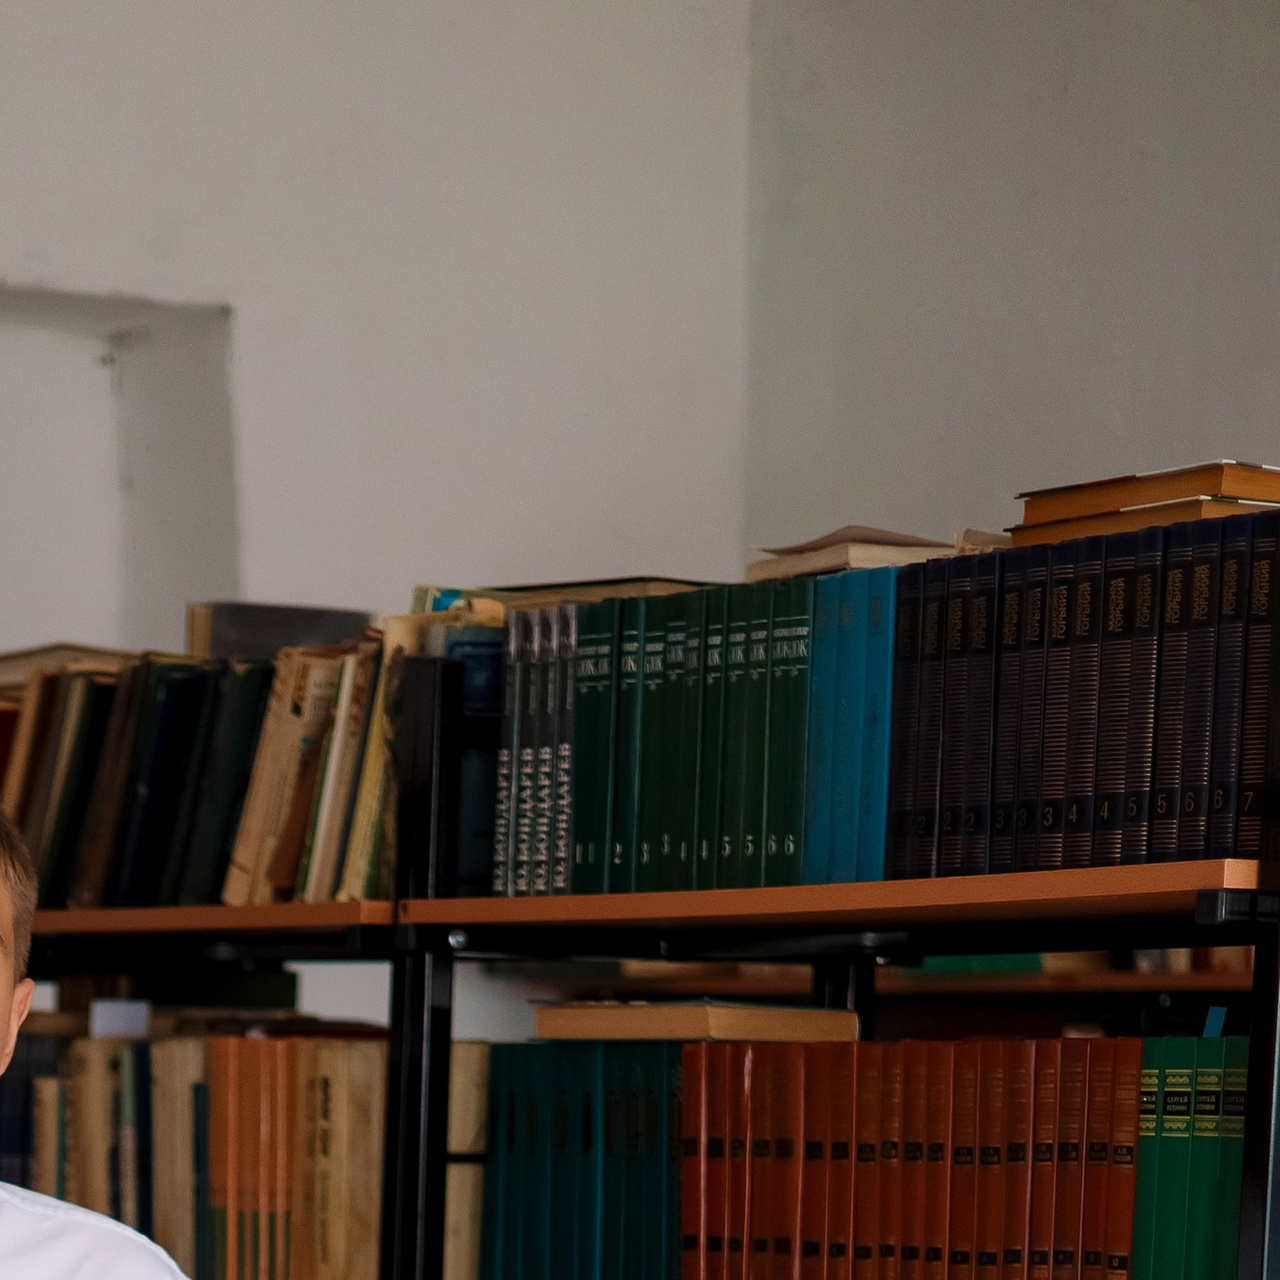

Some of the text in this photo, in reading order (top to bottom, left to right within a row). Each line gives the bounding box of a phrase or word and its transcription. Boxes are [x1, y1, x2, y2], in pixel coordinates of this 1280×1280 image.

[494, 747, 511, 862] БОНДАРЕВ
[518, 746, 535, 862] БОНДАРЕВ
[535, 745, 554, 862] БОНДАРЕВ
[554, 742, 572, 859] БОНДАРЕВ
[1127, 796, 1137, 817] 5
[1156, 794, 1167, 814] 5
[1184, 791, 1195, 812] 6
[1213, 788, 1223, 809] 6
[1243, 791, 1255, 812] 7
[1042, 807, 1054, 827] 3
[1068, 803, 1078, 824] 4
[1100, 800, 1110, 821] 4
[721, 835, 731, 857] 5
[744, 834, 754, 857] 5
[767, 833, 777, 856] 6
[784, 833, 795, 856] 6
